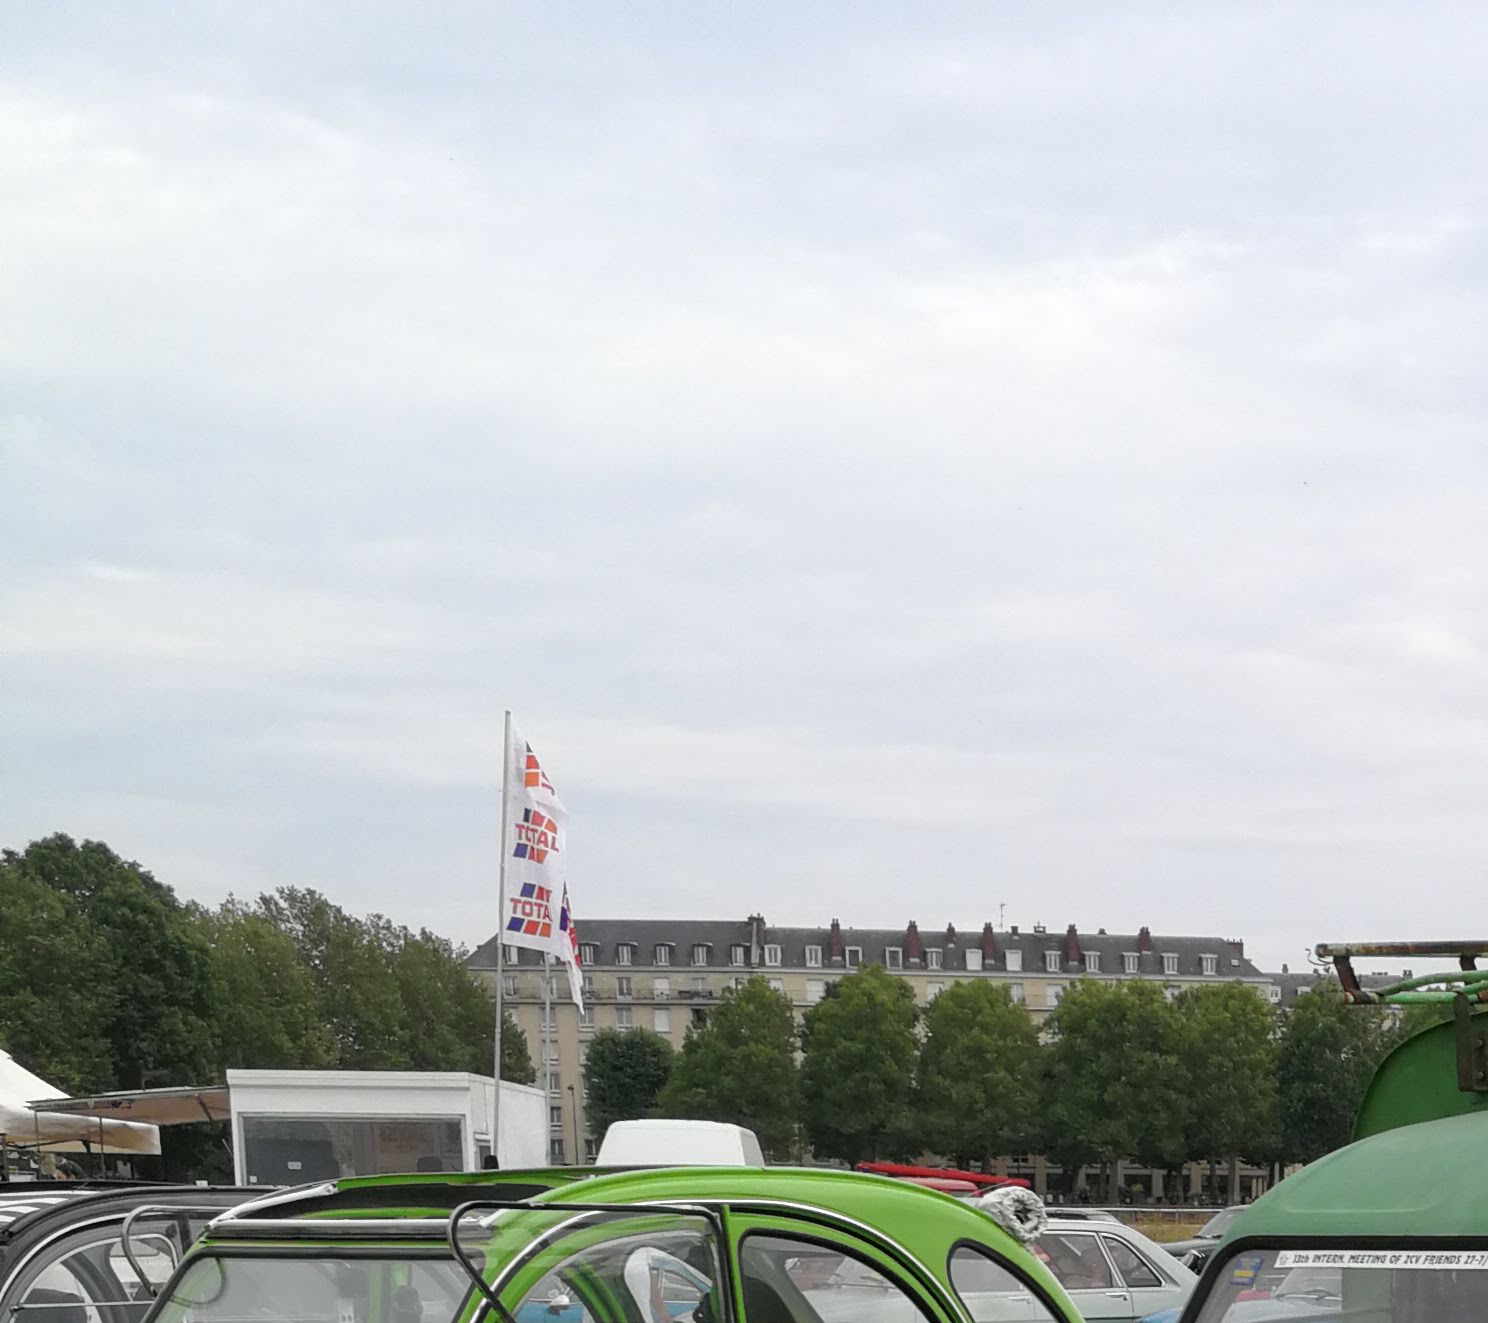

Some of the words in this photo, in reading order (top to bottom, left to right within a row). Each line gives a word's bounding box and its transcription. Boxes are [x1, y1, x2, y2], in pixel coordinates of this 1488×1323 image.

[510, 898, 553, 923] TOTA
[1348, 1254, 1387, 1264] MEETING
[1389, 1254, 1402, 1264] OF
[1404, 1254, 1421, 1265] 2CV
[1423, 1255, 1462, 1265] FRIENDS
